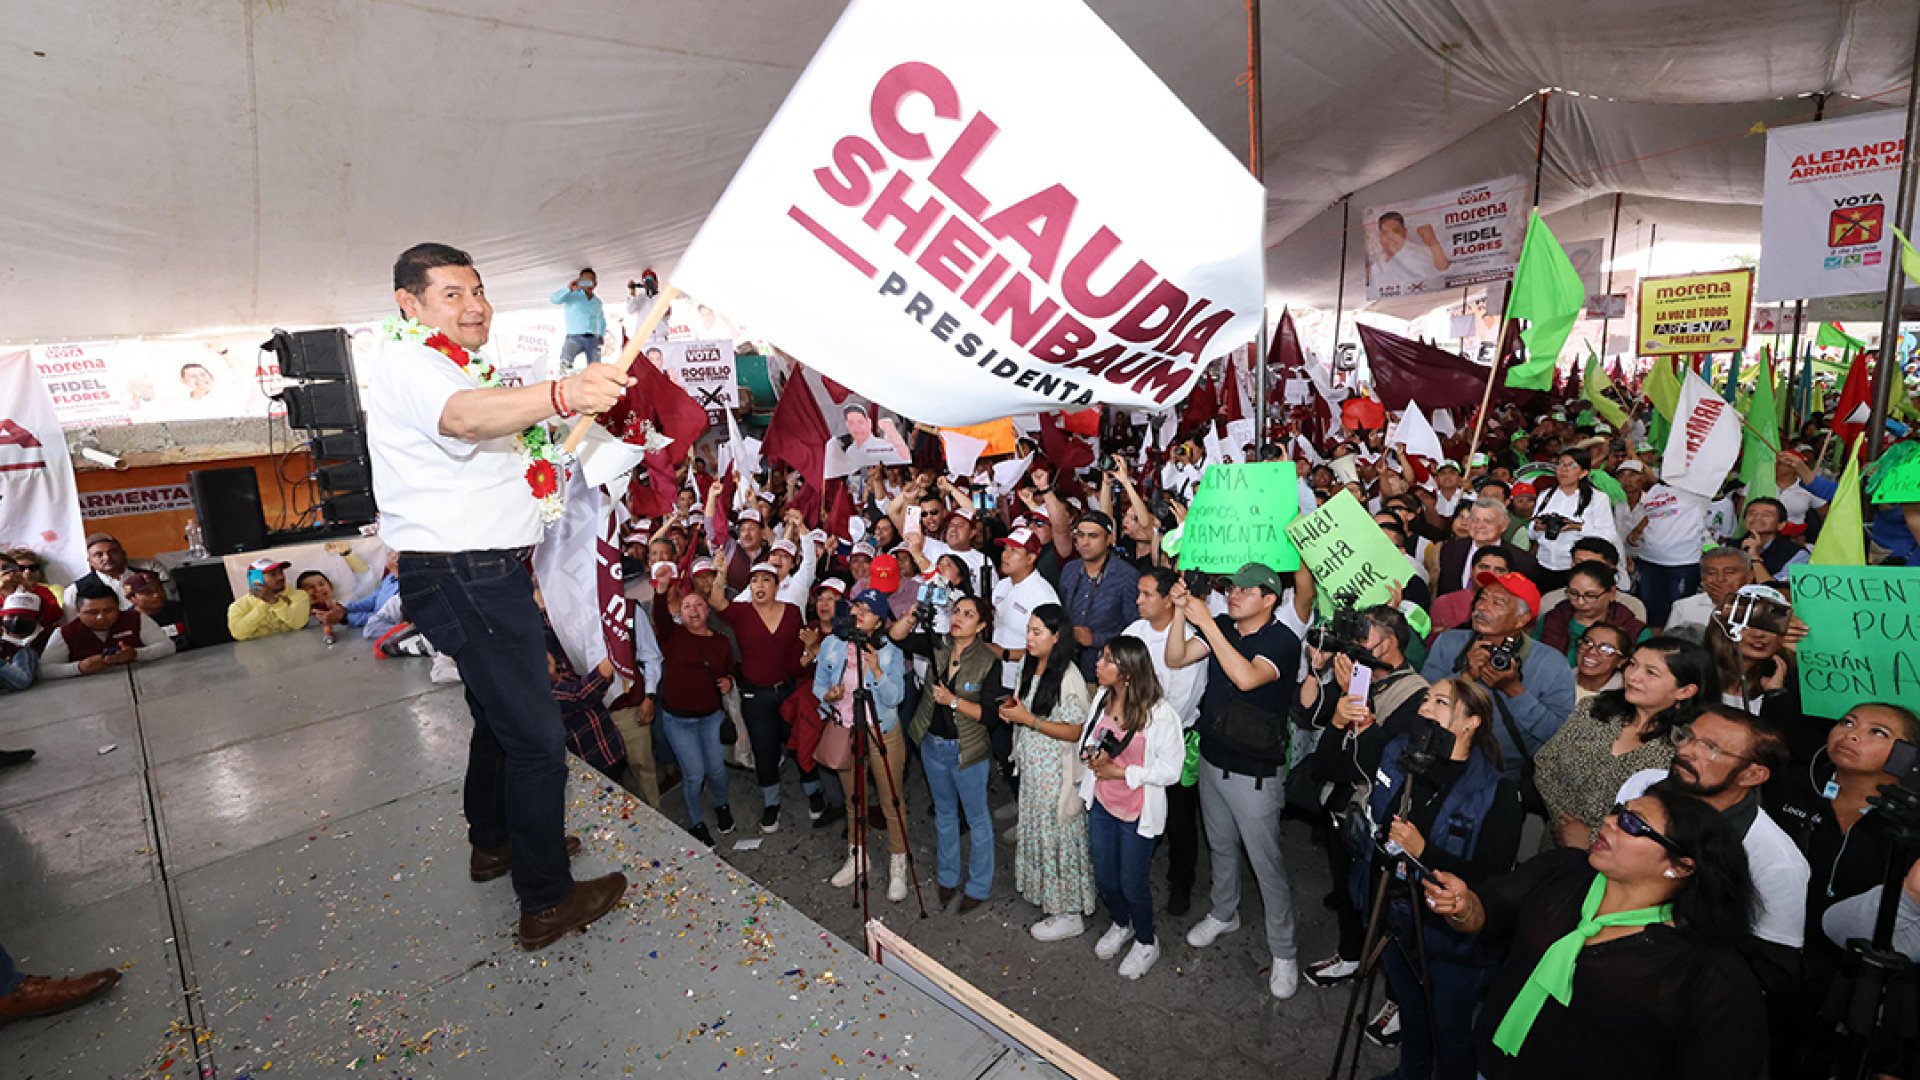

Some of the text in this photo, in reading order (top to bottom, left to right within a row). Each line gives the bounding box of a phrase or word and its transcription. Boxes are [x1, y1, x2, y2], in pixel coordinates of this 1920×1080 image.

[1789, 157, 1880, 180] ARMENTA
[1833, 193, 1884, 208] VOTA
[870, 61, 1235, 363] CLAUDIA
[1444, 201, 1508, 225] morena
[1452, 226, 1502, 246] FIDEL
[1834, 220, 1877, 245] PT
[1453, 239, 1503, 257] FLORES
[813, 134, 1193, 404] SHEINBAUM
[1656, 281, 1731, 299] morena
[1656, 310, 1667, 321] LA
[1687, 307, 1697, 319] DE
[1700, 305, 1729, 318] TODOS
[878, 271, 1094, 406] PRESIDENTA
[687, 349, 719, 361] VOTA
[681, 365, 731, 379] ROGELIO
[48, 378, 107, 395] FIDEL
[53, 390, 111, 404] FLORES
[1805, 667, 1877, 697] CON
